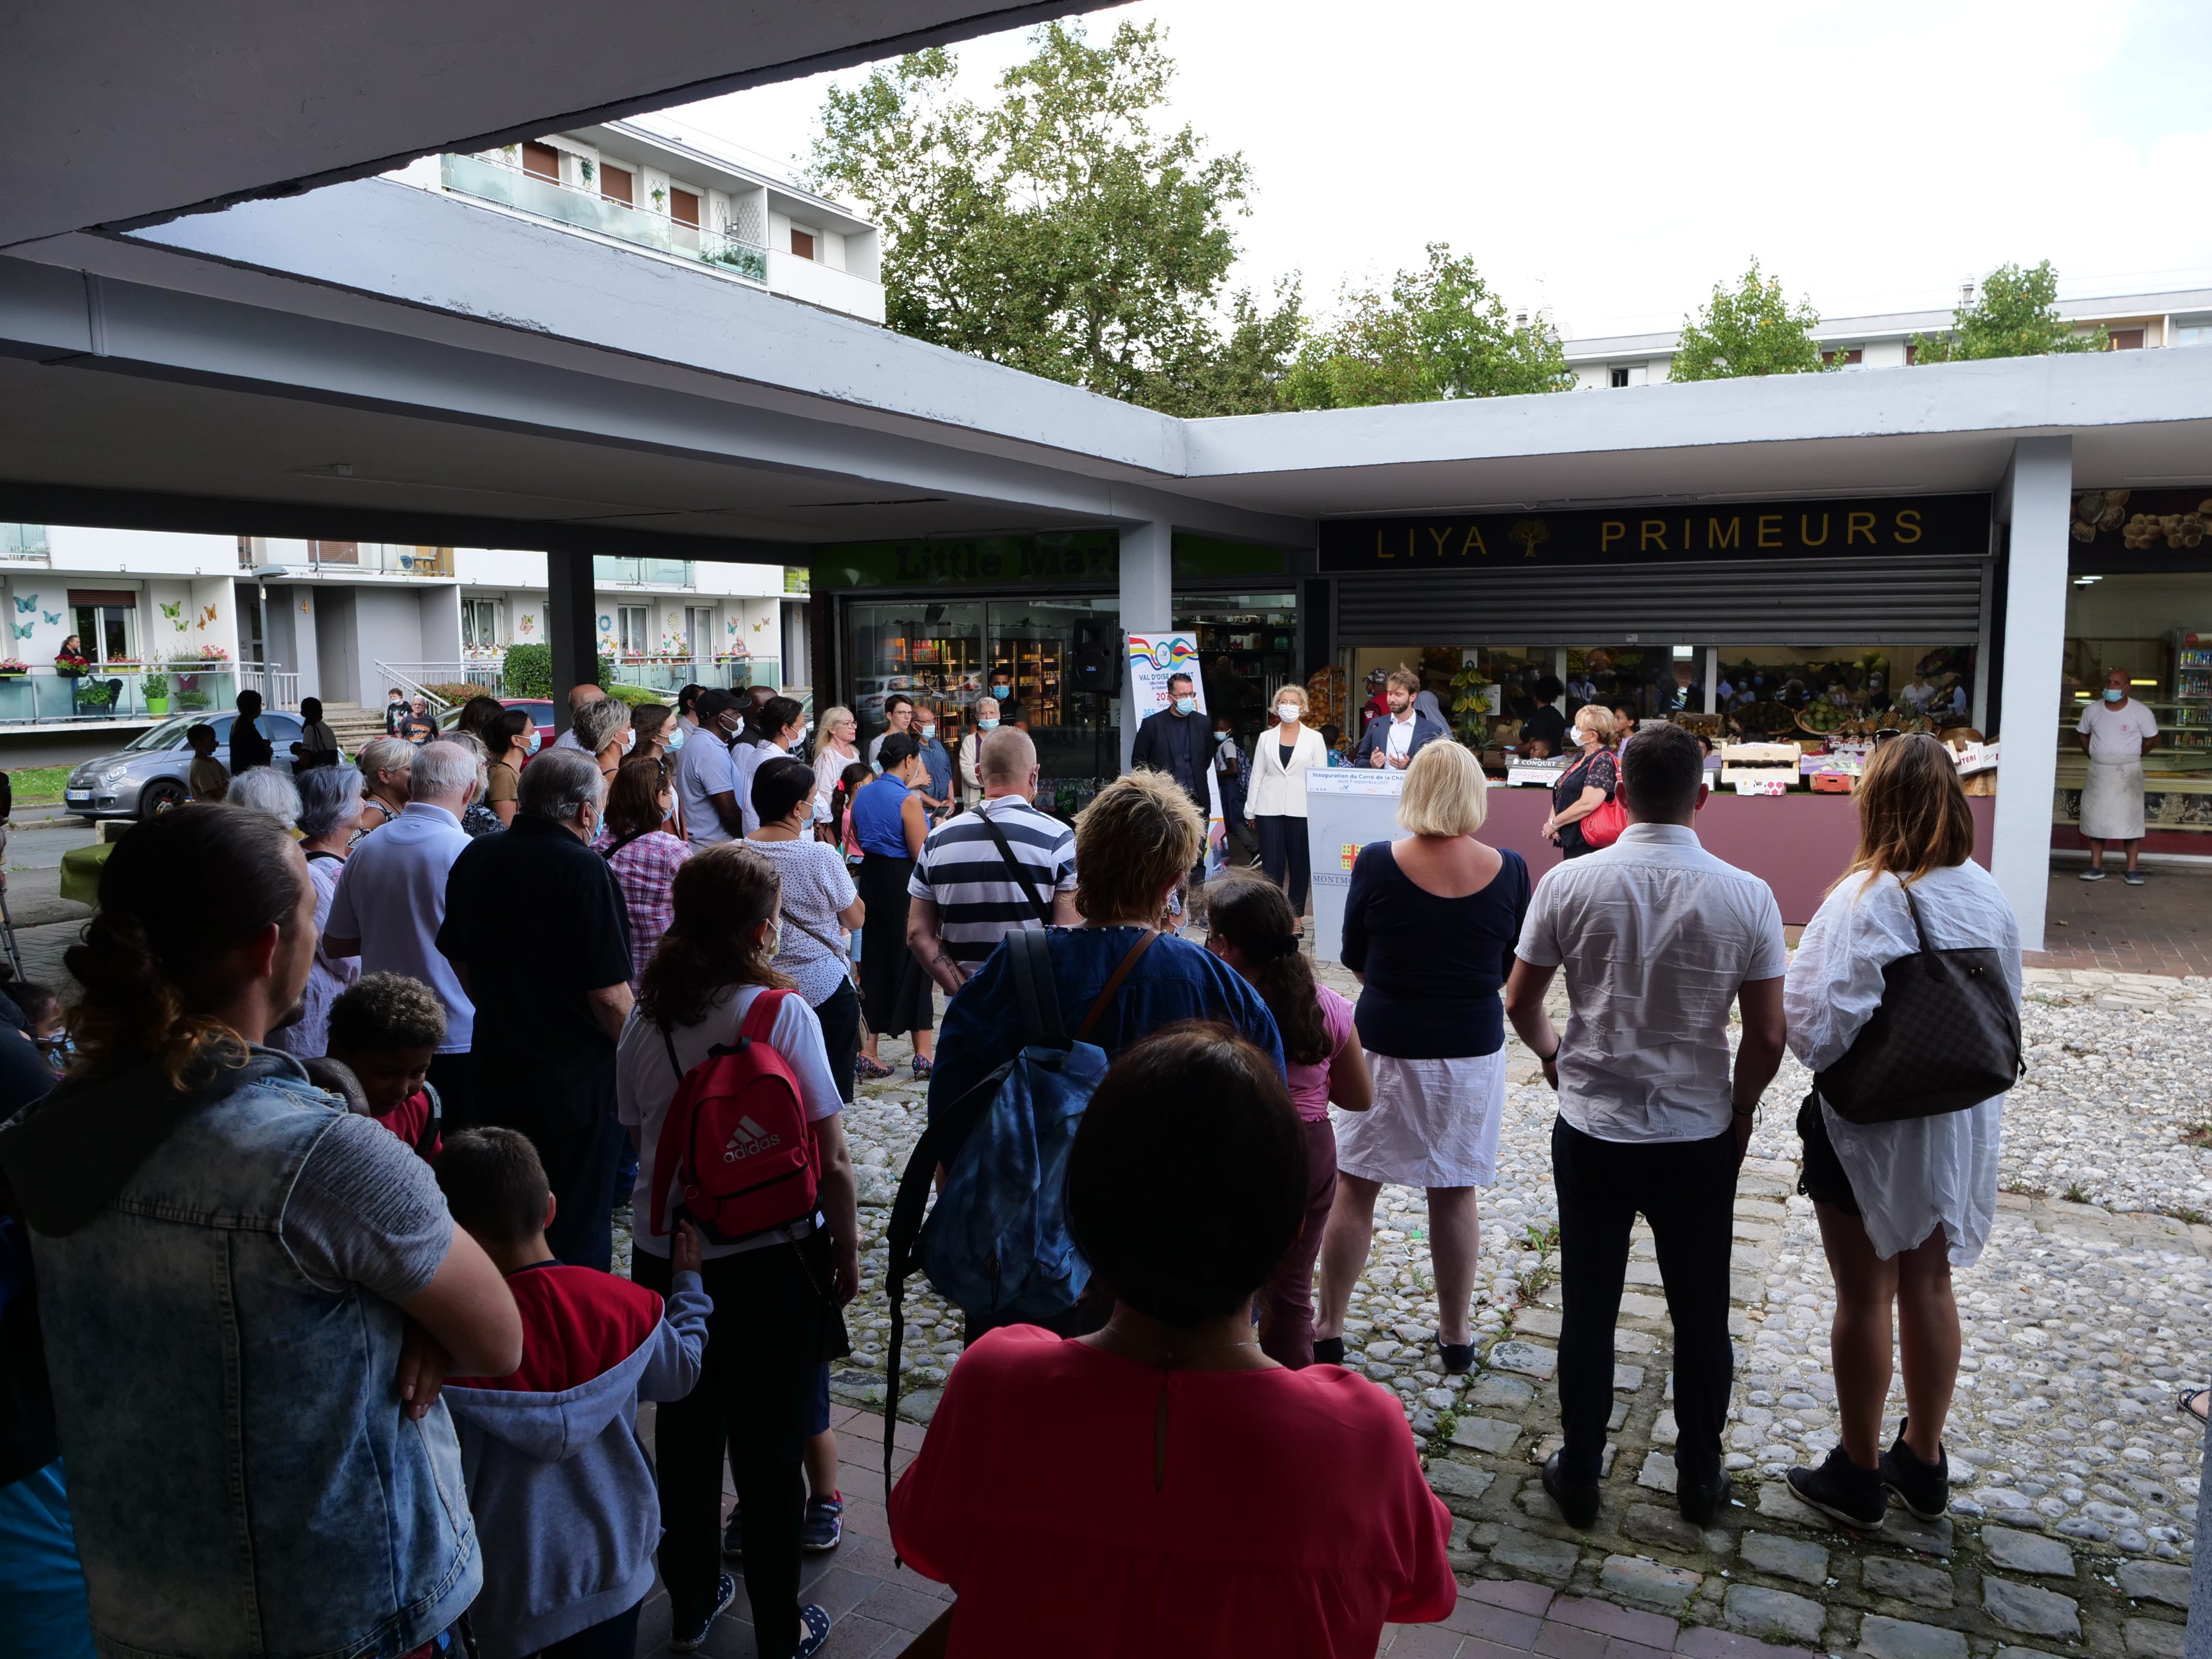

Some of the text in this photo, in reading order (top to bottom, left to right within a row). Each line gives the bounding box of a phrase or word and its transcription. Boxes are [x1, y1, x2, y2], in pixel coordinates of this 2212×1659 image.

[1377, 509, 1923, 559] LIYA PRIMEURS
[895, 543, 1003, 580] Little
[300, 599, 309, 613] 4
[723, 1134, 781, 1163] adidas
